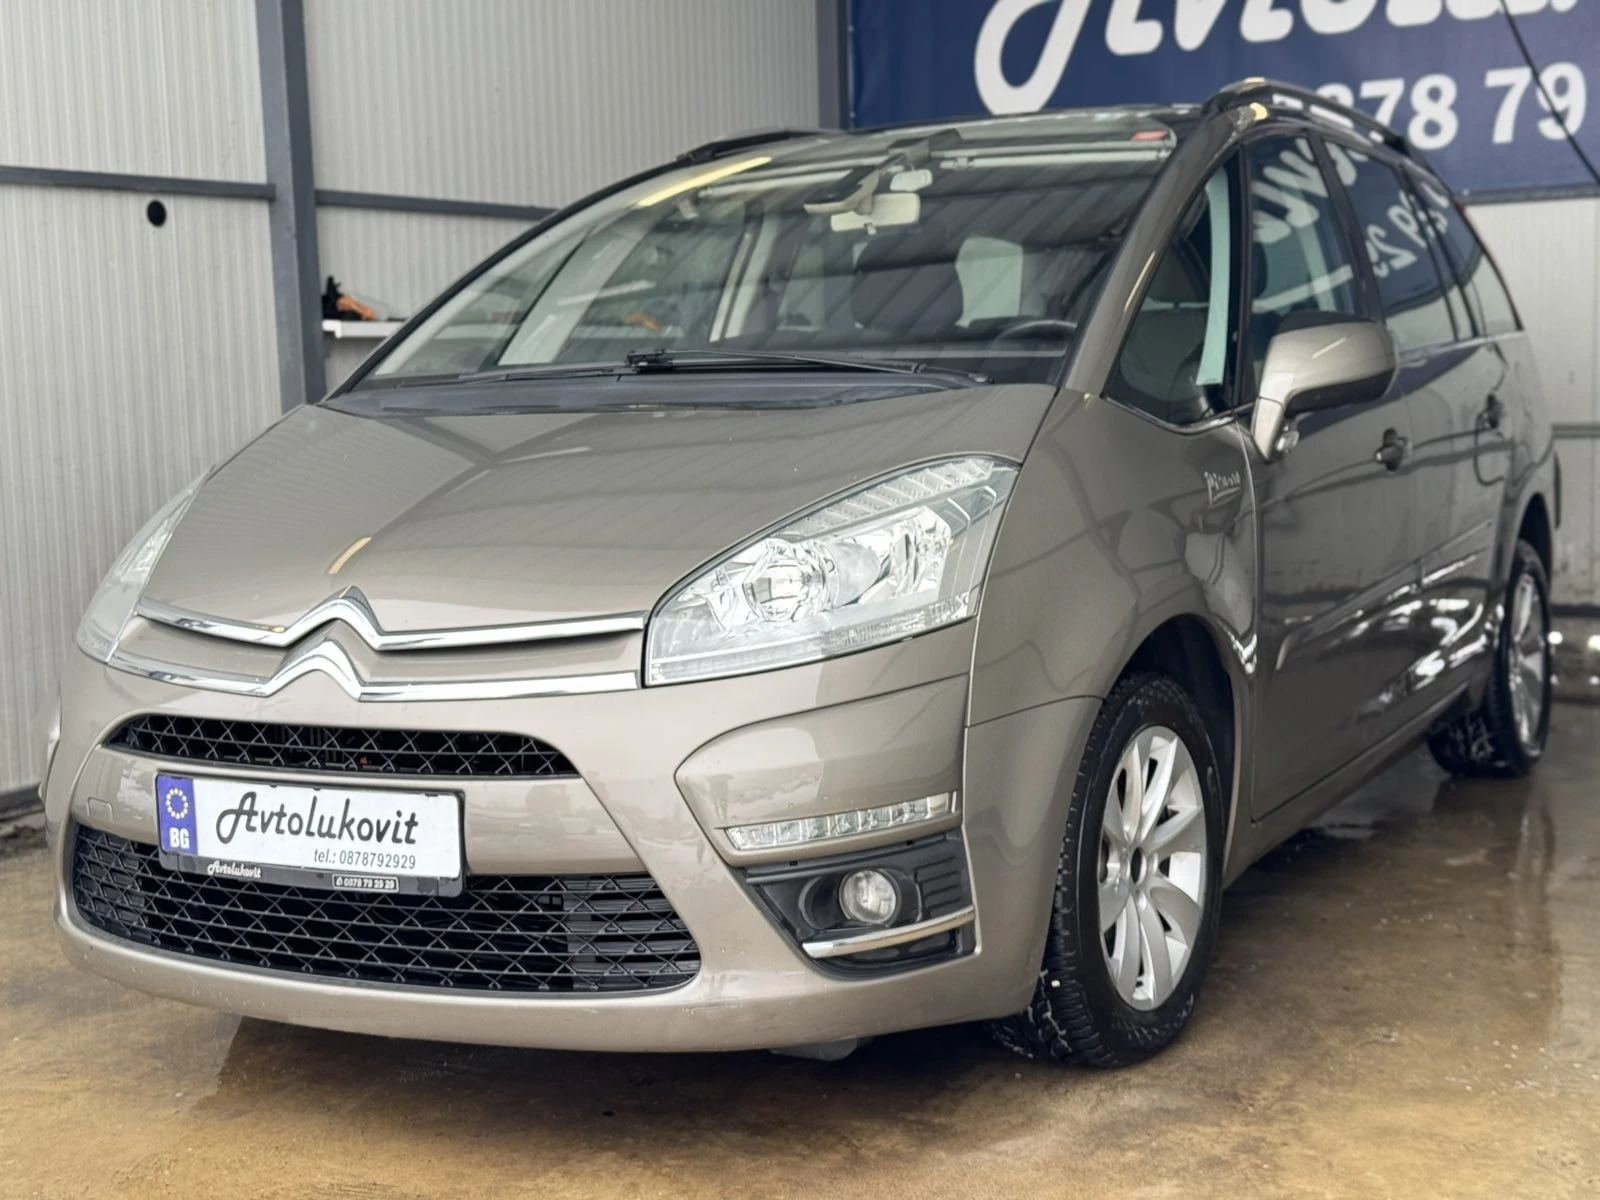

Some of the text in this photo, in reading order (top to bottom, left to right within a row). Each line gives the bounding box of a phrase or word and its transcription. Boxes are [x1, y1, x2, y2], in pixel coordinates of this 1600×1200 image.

[1485, 62, 1587, 144] 79
[216, 791, 419, 844] Avtolukovit
[169, 827, 190, 849] BG
[313, 848, 416, 870] tel.: 0878792929
